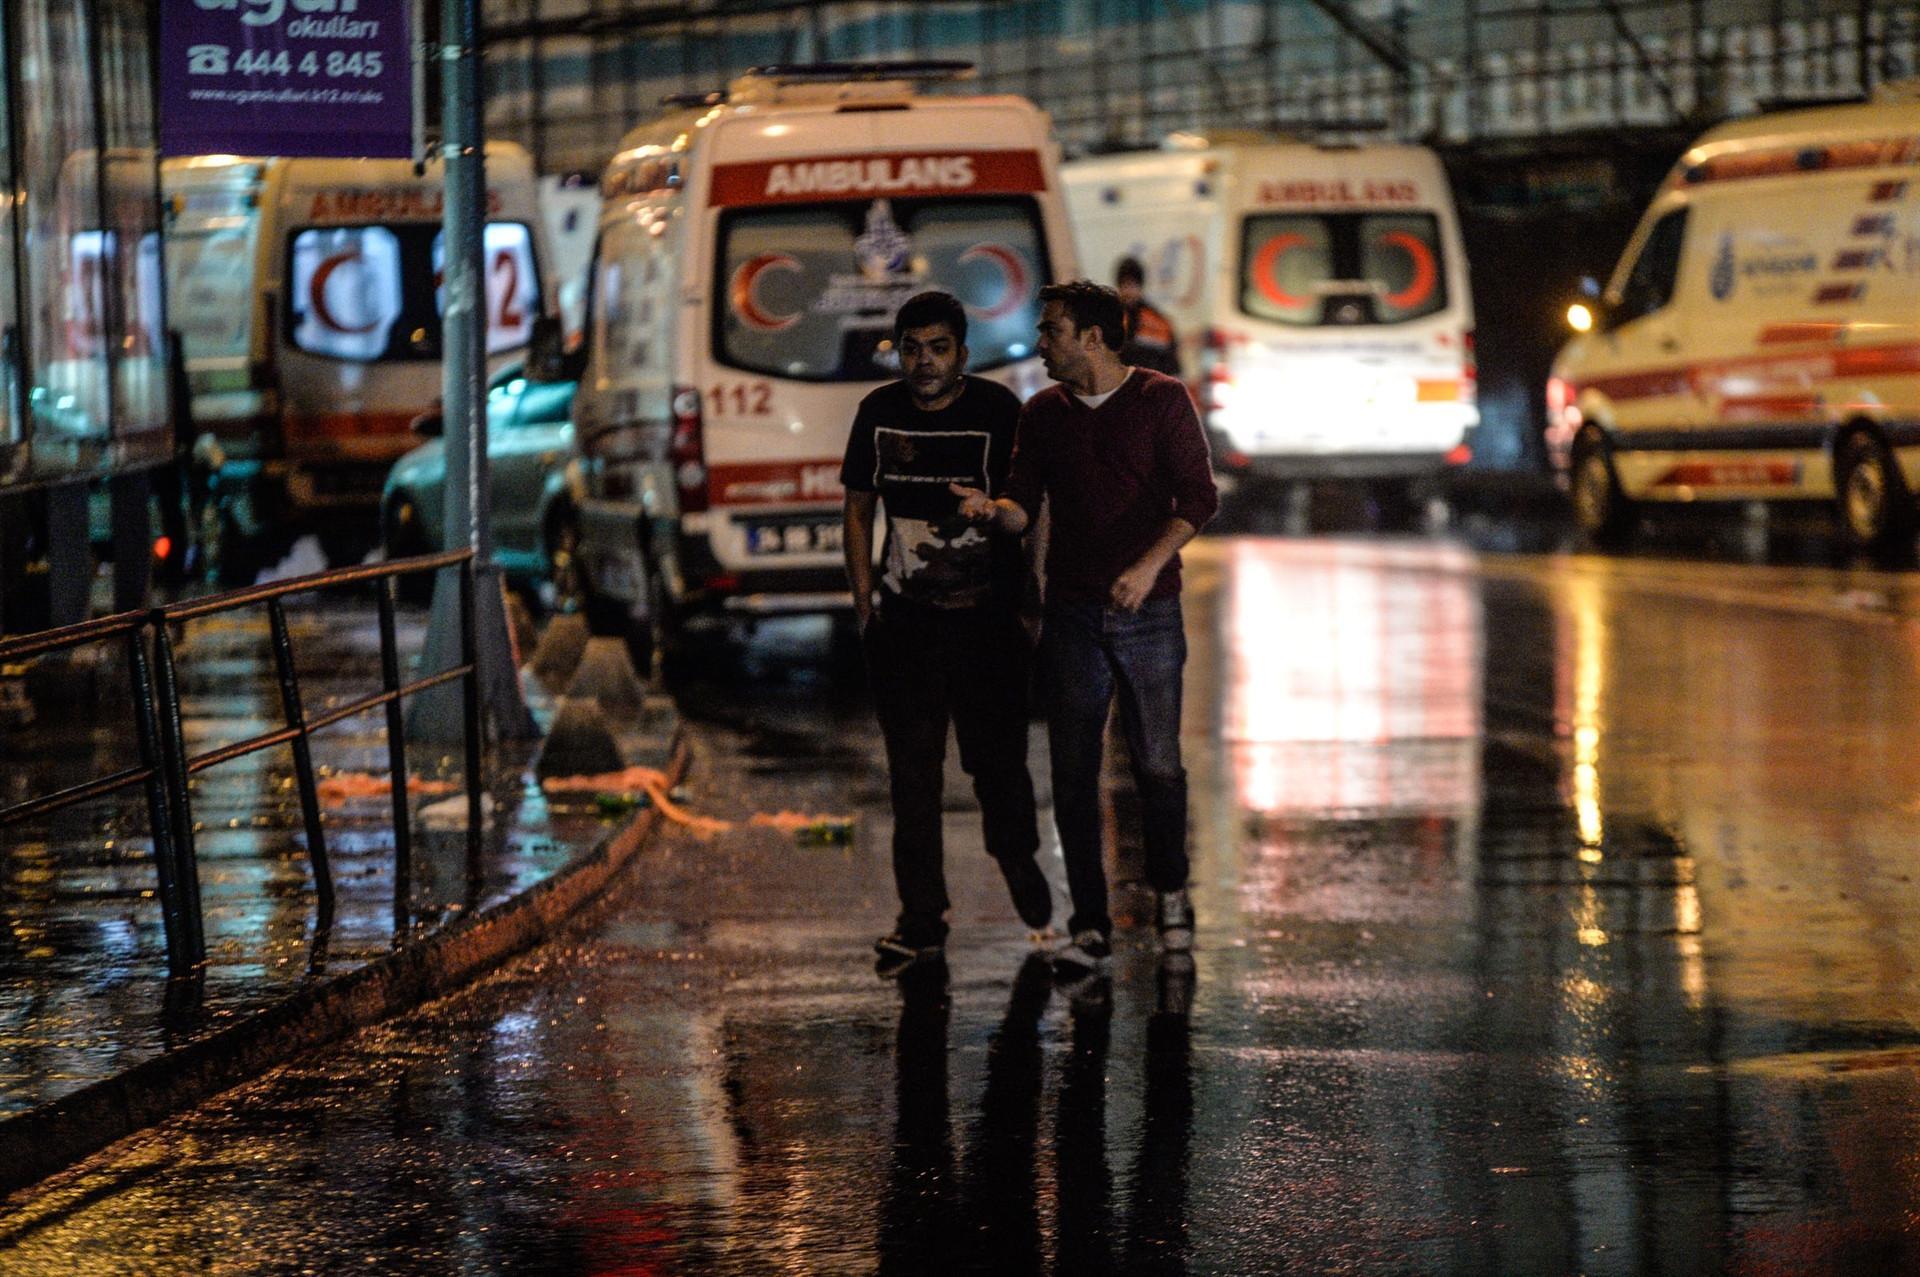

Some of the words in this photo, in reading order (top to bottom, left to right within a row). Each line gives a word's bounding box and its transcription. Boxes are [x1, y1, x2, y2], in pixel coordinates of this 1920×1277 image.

[234, 50, 292, 76] 444
[299, 50, 320, 77] 4
[326, 51, 383, 78] 845
[765, 156, 975, 196] AMBULANS
[1258, 181, 1419, 205] AMBULANS
[706, 383, 774, 416] 112
